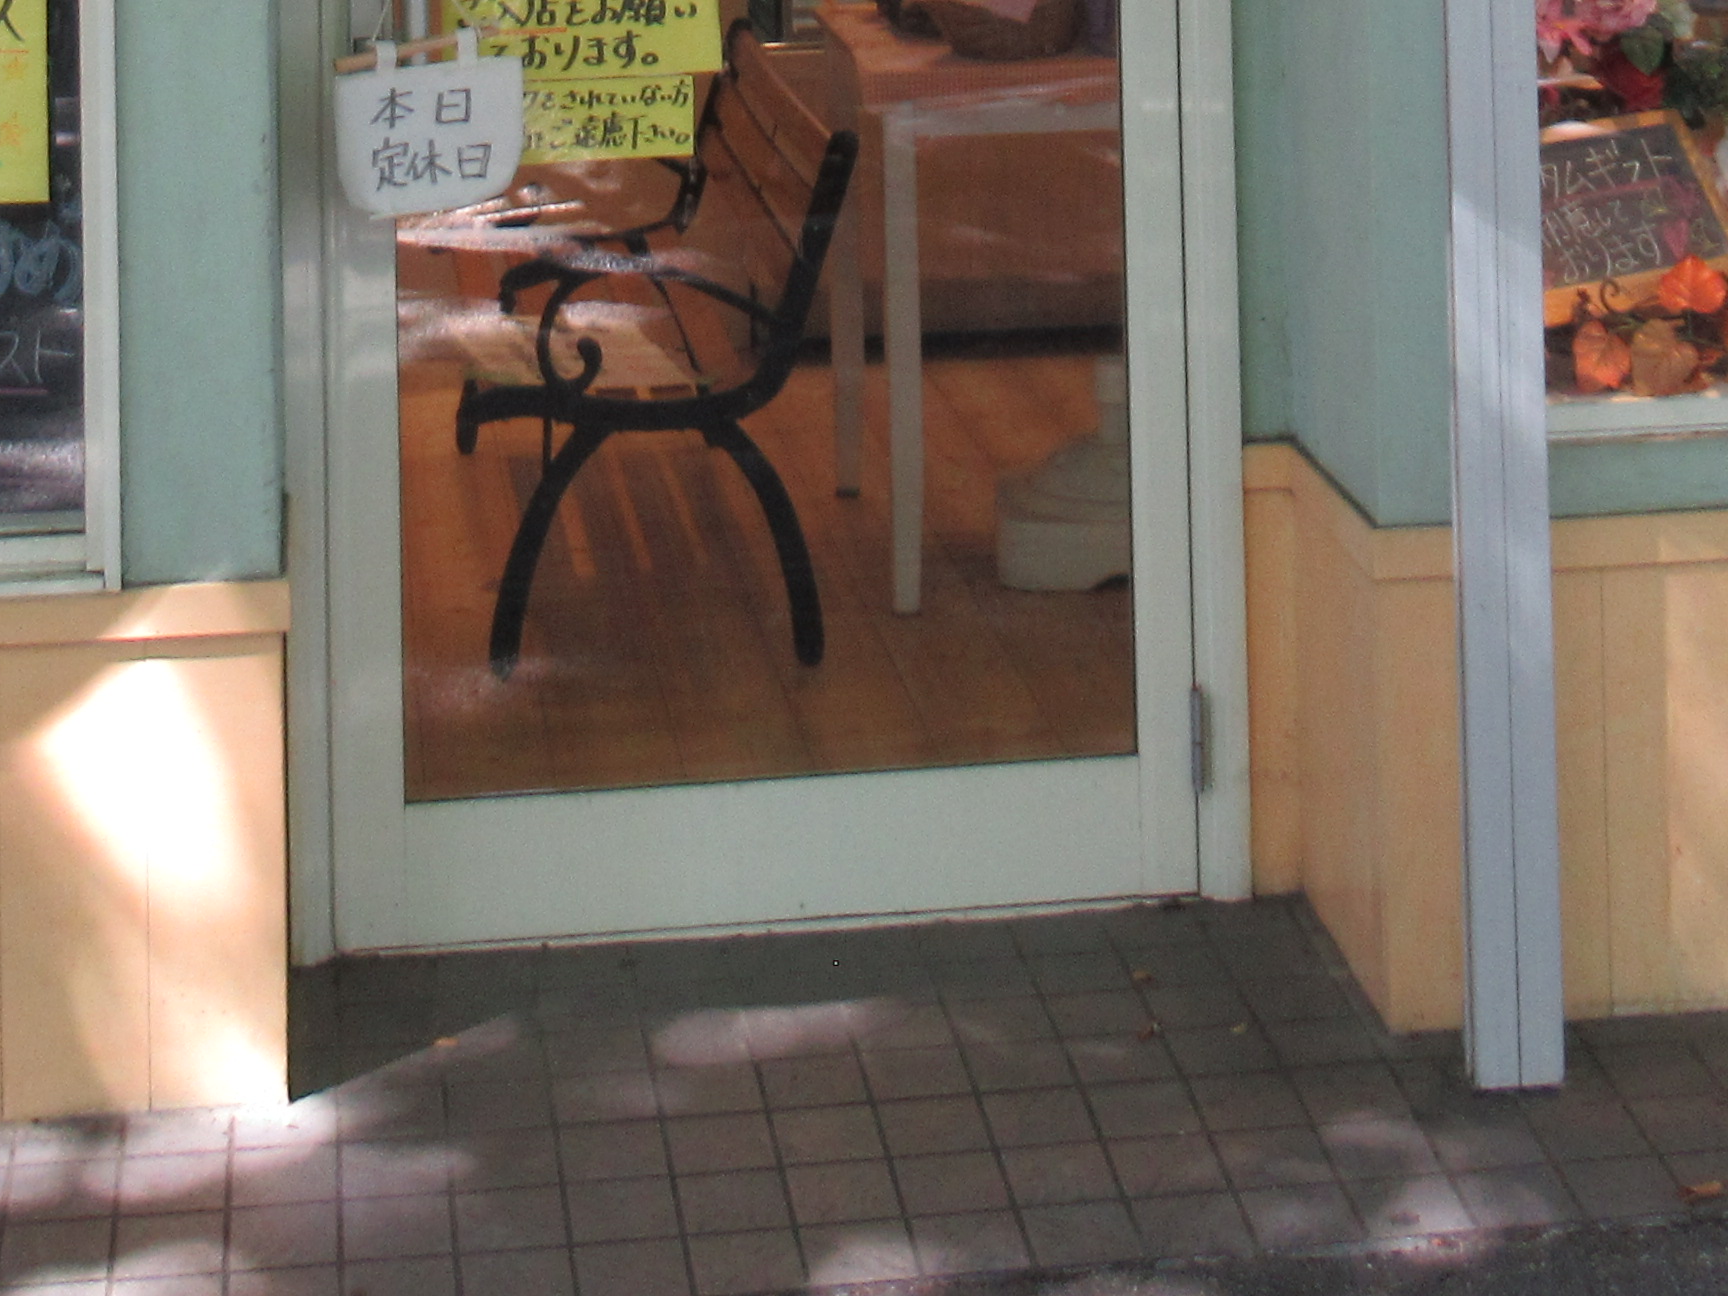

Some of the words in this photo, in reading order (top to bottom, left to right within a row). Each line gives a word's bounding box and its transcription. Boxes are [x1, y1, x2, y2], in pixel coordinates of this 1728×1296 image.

[371, 88, 472, 129] 本日
[371, 137, 493, 192] 定休日
